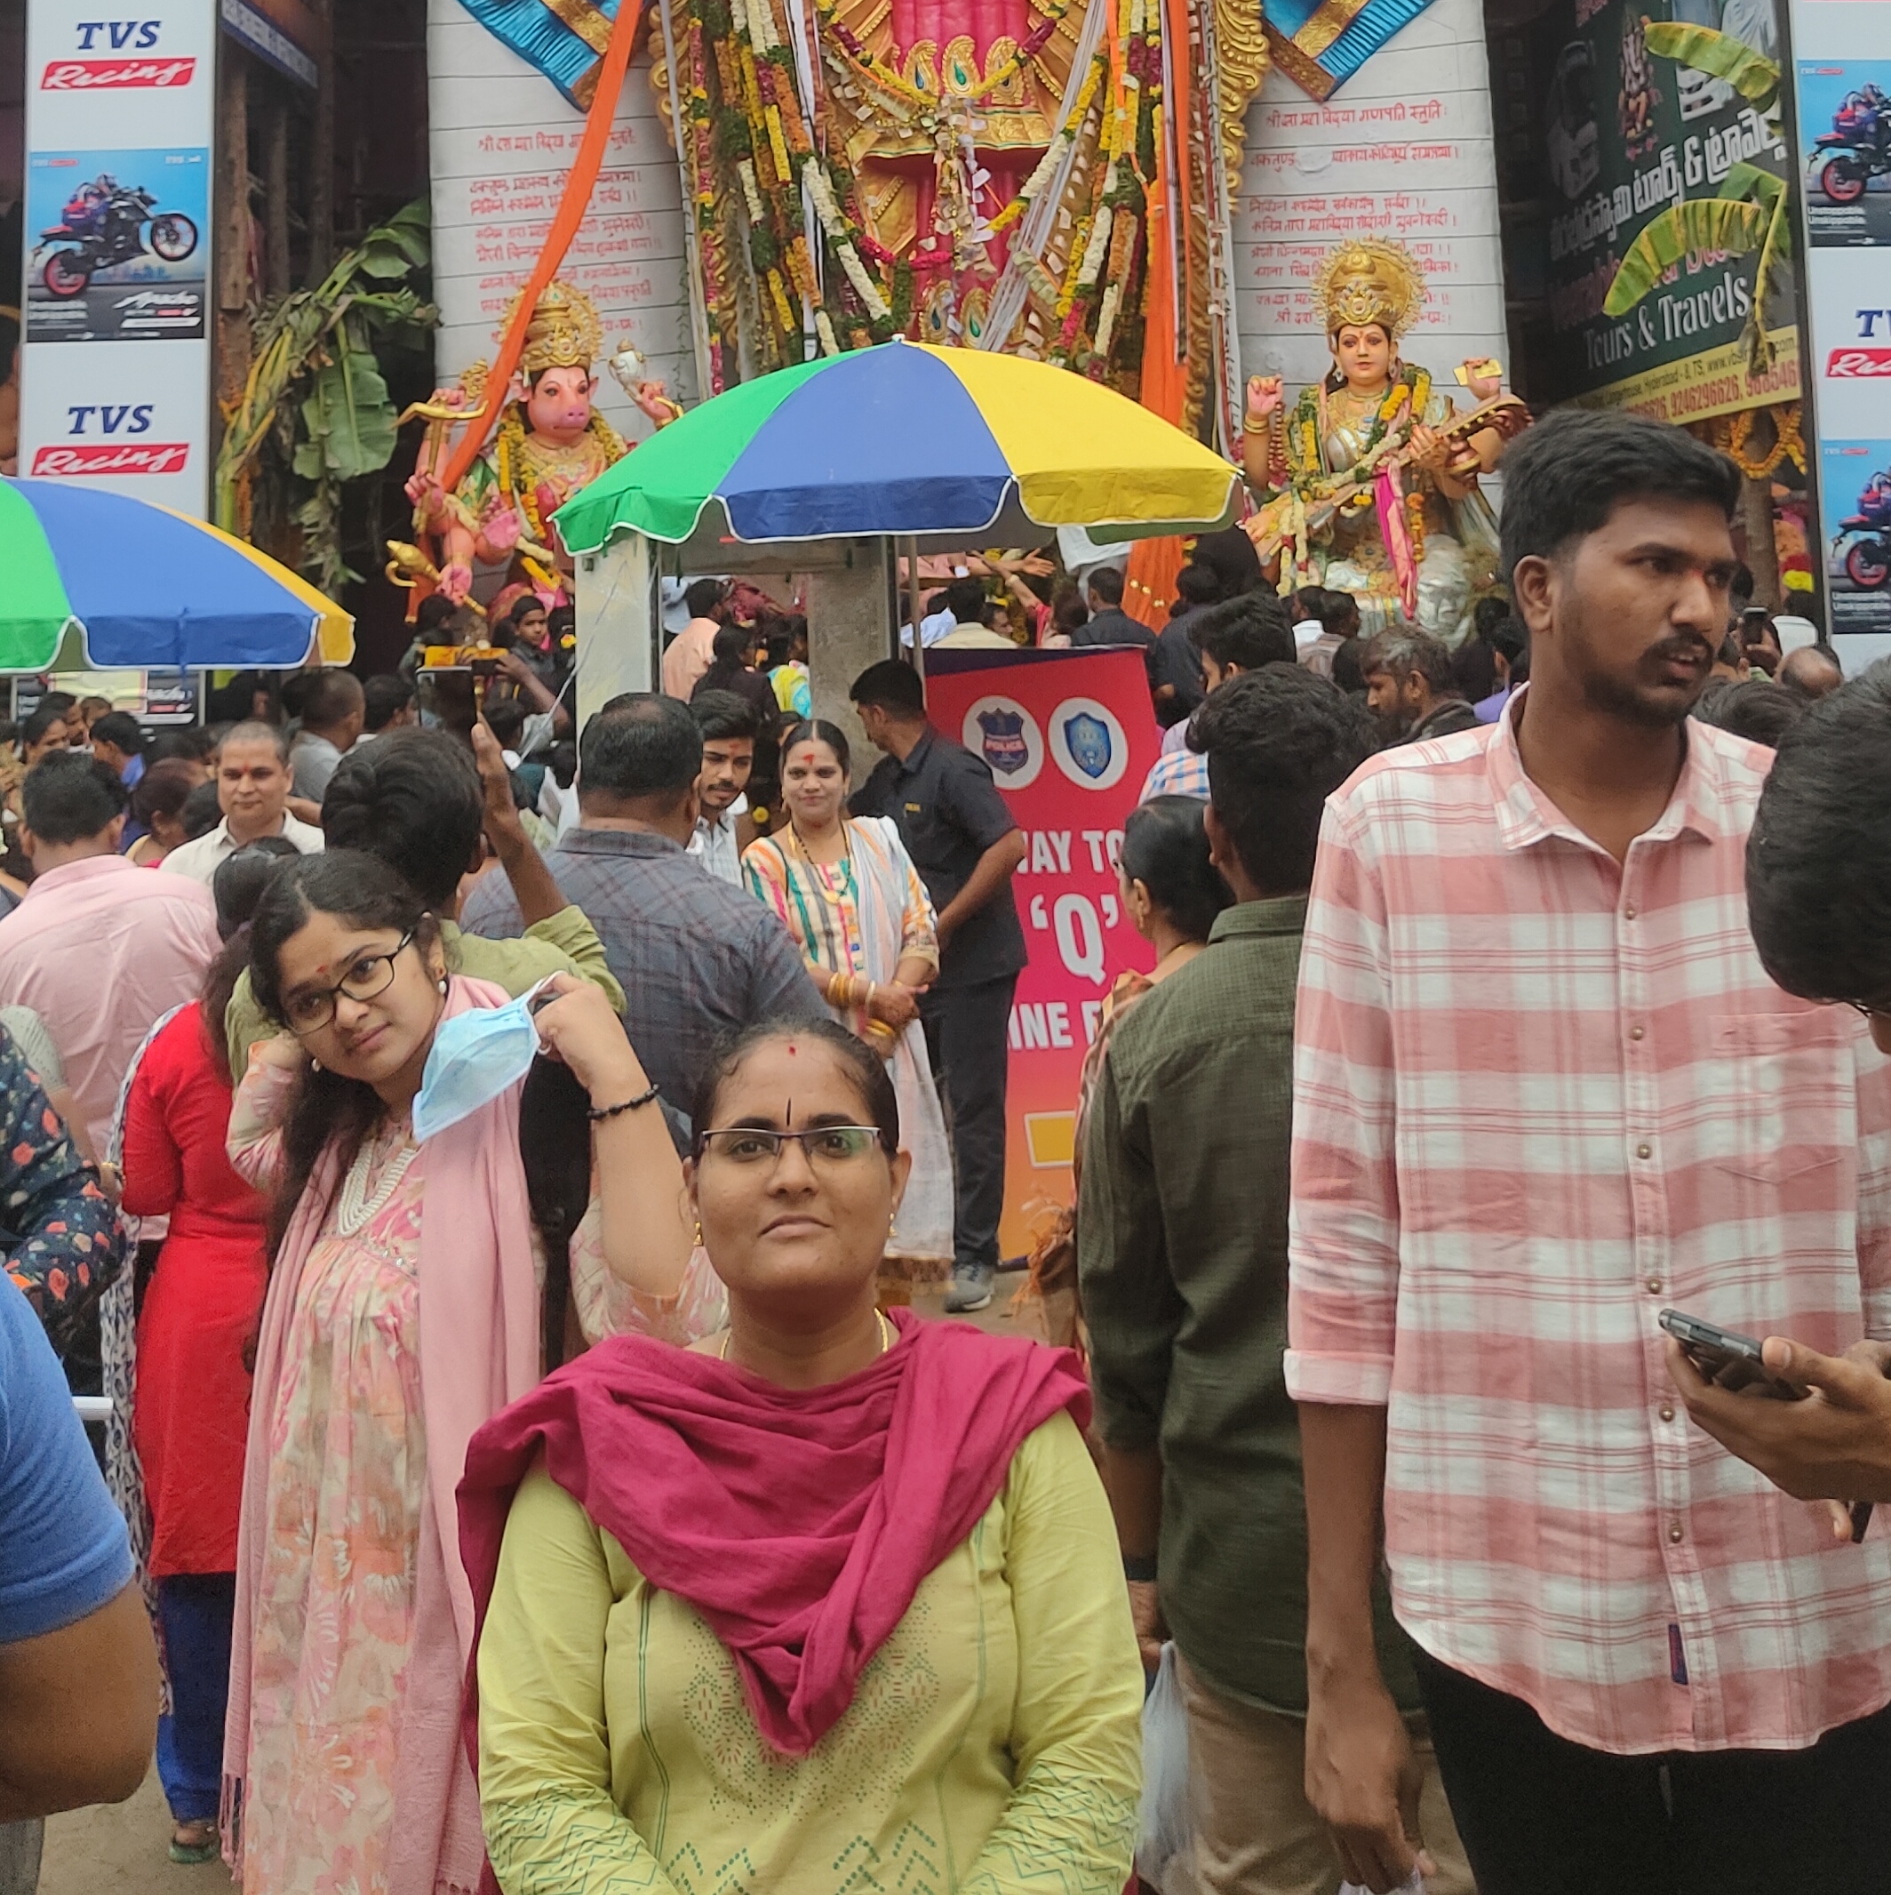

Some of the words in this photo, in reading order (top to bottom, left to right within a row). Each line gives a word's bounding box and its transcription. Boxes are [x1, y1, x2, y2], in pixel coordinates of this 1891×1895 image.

[76, 21, 161, 49] TVS
[45, 59, 193, 89] Racing
[1359, 102, 1406, 122] गणपति
[1684, 135, 1703, 187] &
[1638, 305, 1658, 351] &
[1658, 271, 1752, 344] Travels
[68, 405, 153, 434] TVS
[35, 444, 187, 474] Racing
[1007, 1001, 1073, 1051] INE
